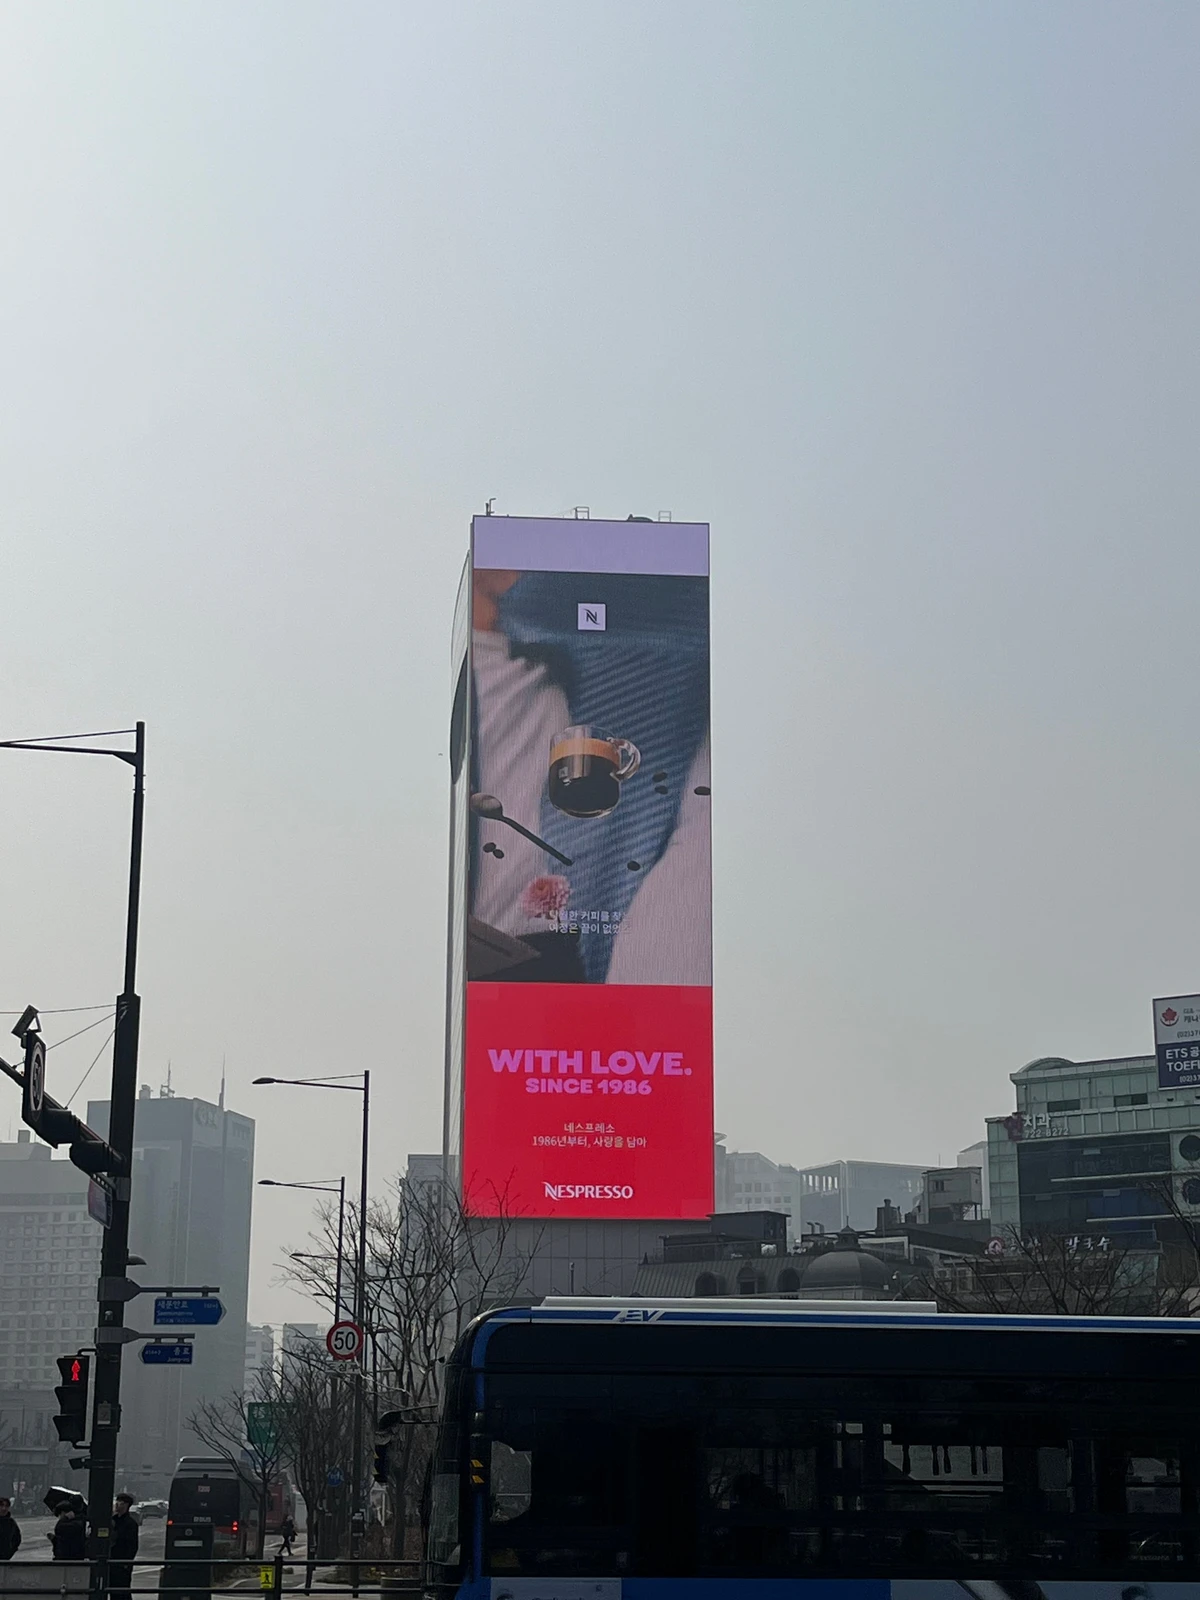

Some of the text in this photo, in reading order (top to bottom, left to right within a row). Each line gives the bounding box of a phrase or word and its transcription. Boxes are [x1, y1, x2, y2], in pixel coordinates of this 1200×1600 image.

[581, 910, 610, 922] 커피를
[549, 923, 578, 934] 여정은
[581, 923, 600, 934] 끝이
[1166, 1047, 1188, 1060] ETS
[487, 1048, 692, 1076] WITH LOVE.
[525, 1077, 652, 1095] SINCE 1986
[1023, 1112, 1051, 1130] 치과
[564, 1122, 616, 1134] 네스프레소
[532, 1135, 648, 1148] 1986년부터, 사랑을 담아
[542, 1181, 633, 1201] NESPRESSO
[626, 1309, 660, 1322] EV
[334, 1331, 355, 1350] 50
